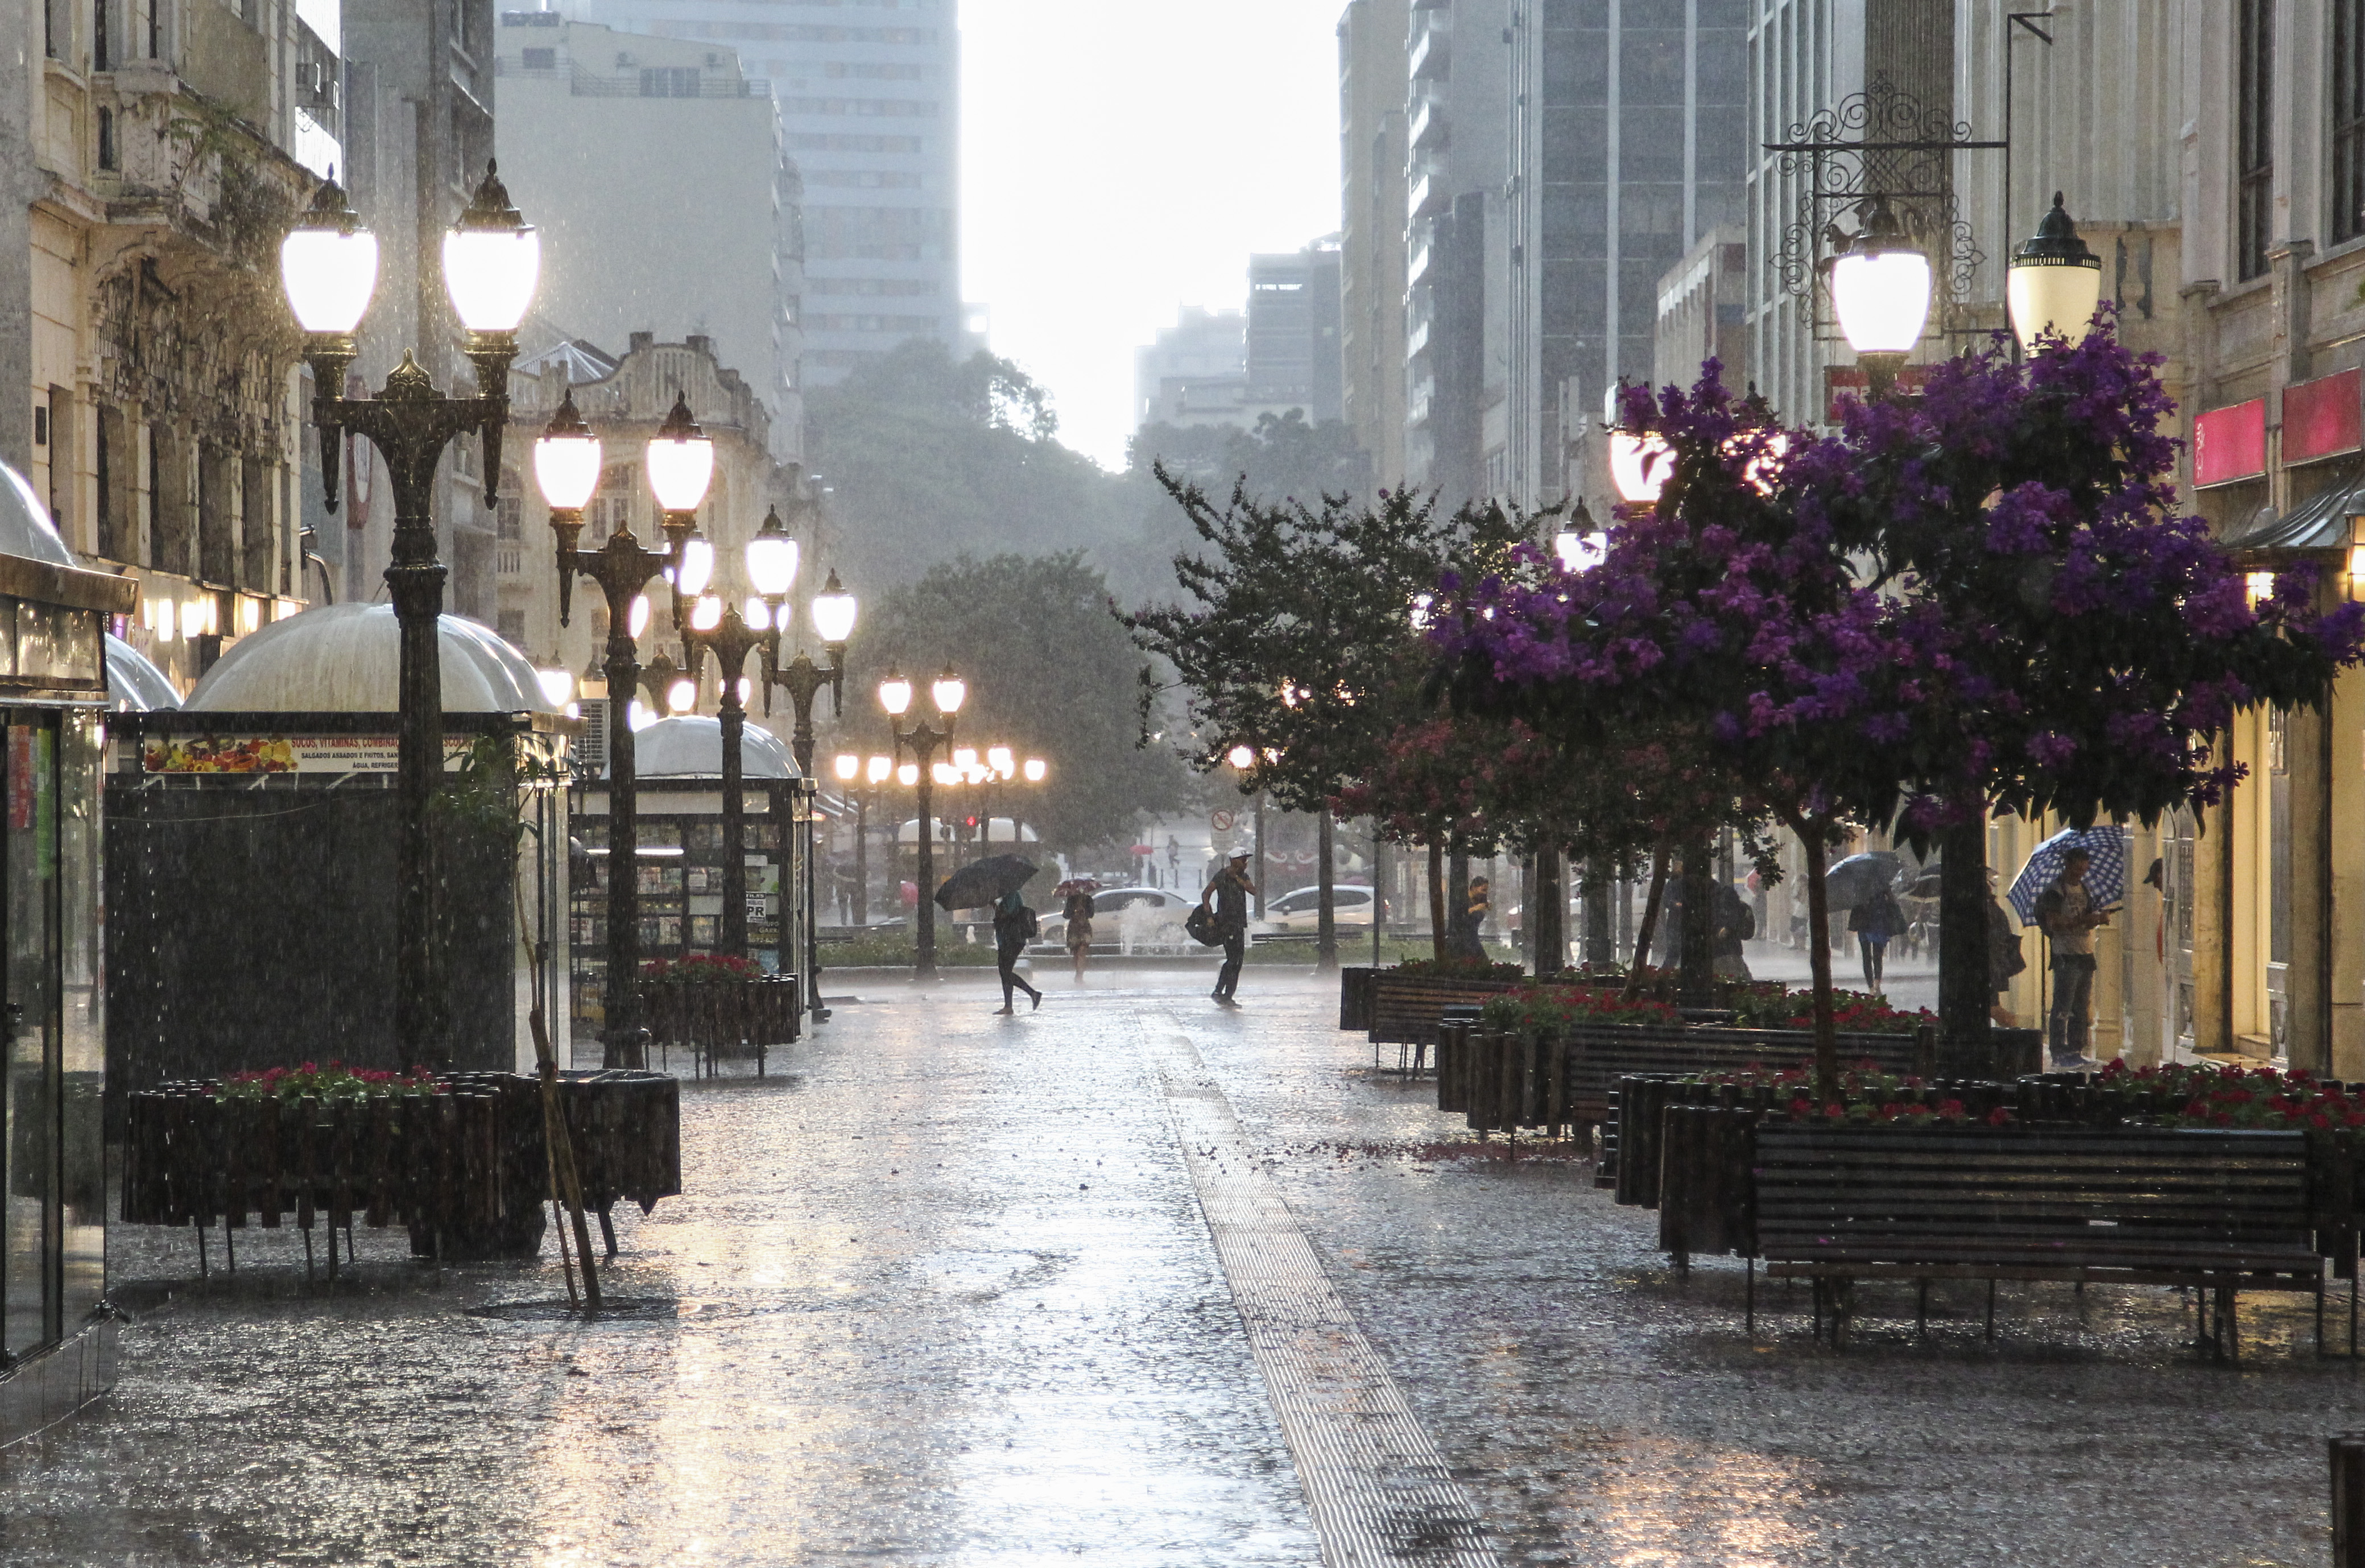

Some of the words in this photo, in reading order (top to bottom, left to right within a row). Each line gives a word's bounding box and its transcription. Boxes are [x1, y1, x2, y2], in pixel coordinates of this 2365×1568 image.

[291, 737, 318, 749] SUCOS,
[320, 737, 360, 749] VITAMINAS,
[747, 907, 764, 916] PR
